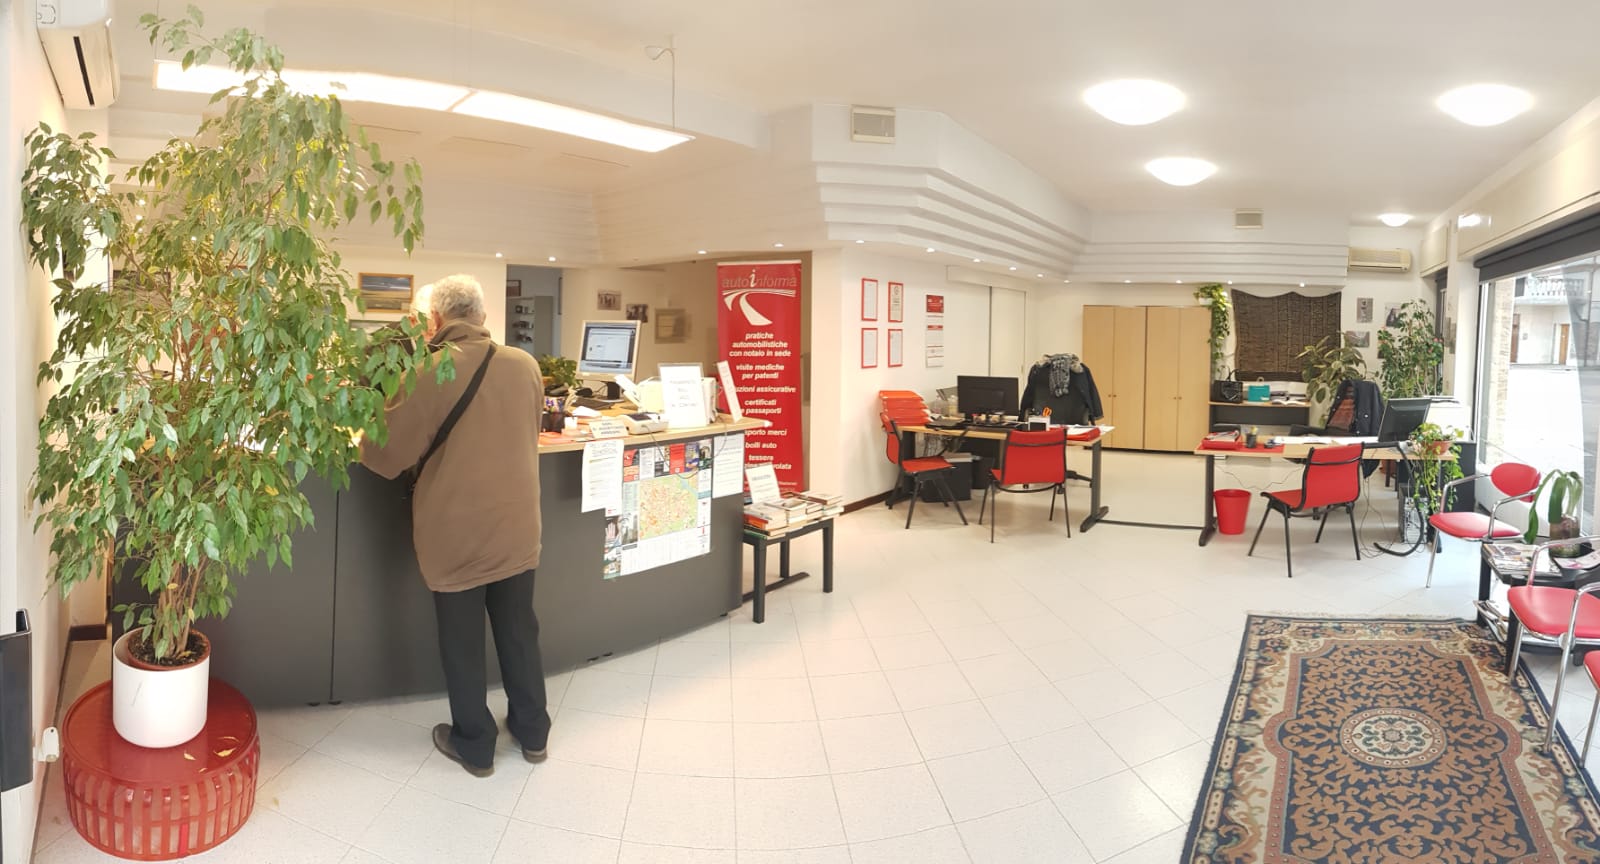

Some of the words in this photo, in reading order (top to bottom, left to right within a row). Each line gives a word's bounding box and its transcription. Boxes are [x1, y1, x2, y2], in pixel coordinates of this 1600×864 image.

[722, 269, 797, 287] autoinforma
[745, 332, 774, 341] pratiche
[736, 363, 753, 371] visite
[754, 363, 784, 371] mediche
[742, 372, 753, 380] per
[754, 372, 779, 380] patenti
[745, 407, 782, 415] passaporti
[745, 428, 766, 437] sporto
[767, 428, 787, 436] merci
